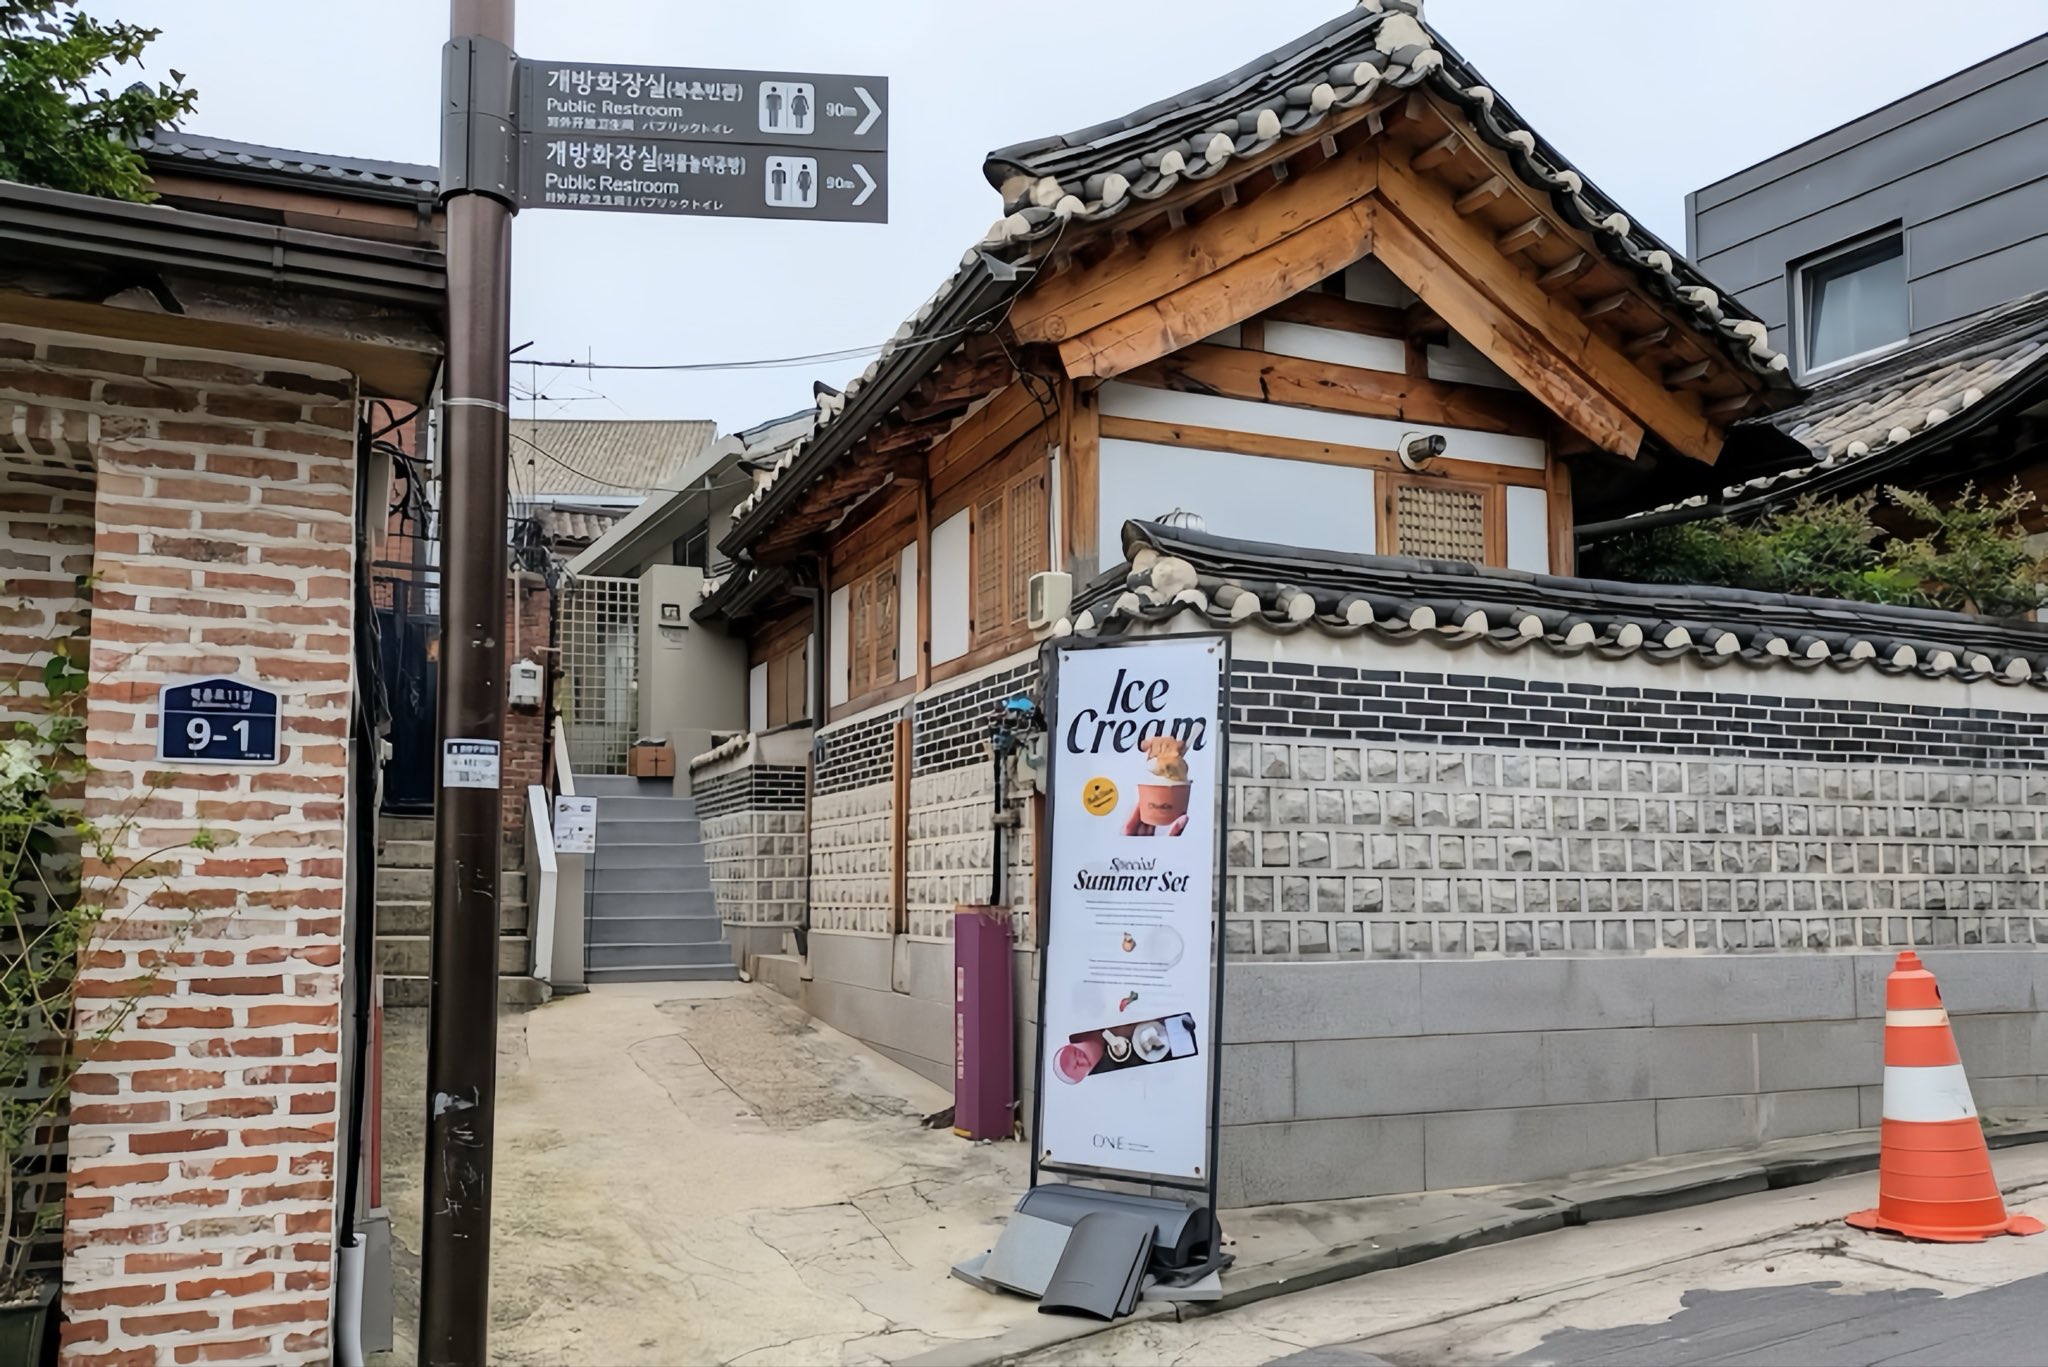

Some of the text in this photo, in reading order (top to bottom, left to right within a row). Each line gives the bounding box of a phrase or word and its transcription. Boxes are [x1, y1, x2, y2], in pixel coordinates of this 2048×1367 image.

[547, 98, 683, 117] Public Restroom
[826, 102, 857, 117] 90m
[642, 120, 734, 134] パブリックトイレ
[546, 173, 679, 194] Public Restroom
[826, 176, 855, 189] 90m
[1106, 668, 1169, 715] Ice
[186, 717, 249, 752] 9-1
[1066, 708, 1208, 754] Cream
[1073, 869, 1190, 892] Summer Set
